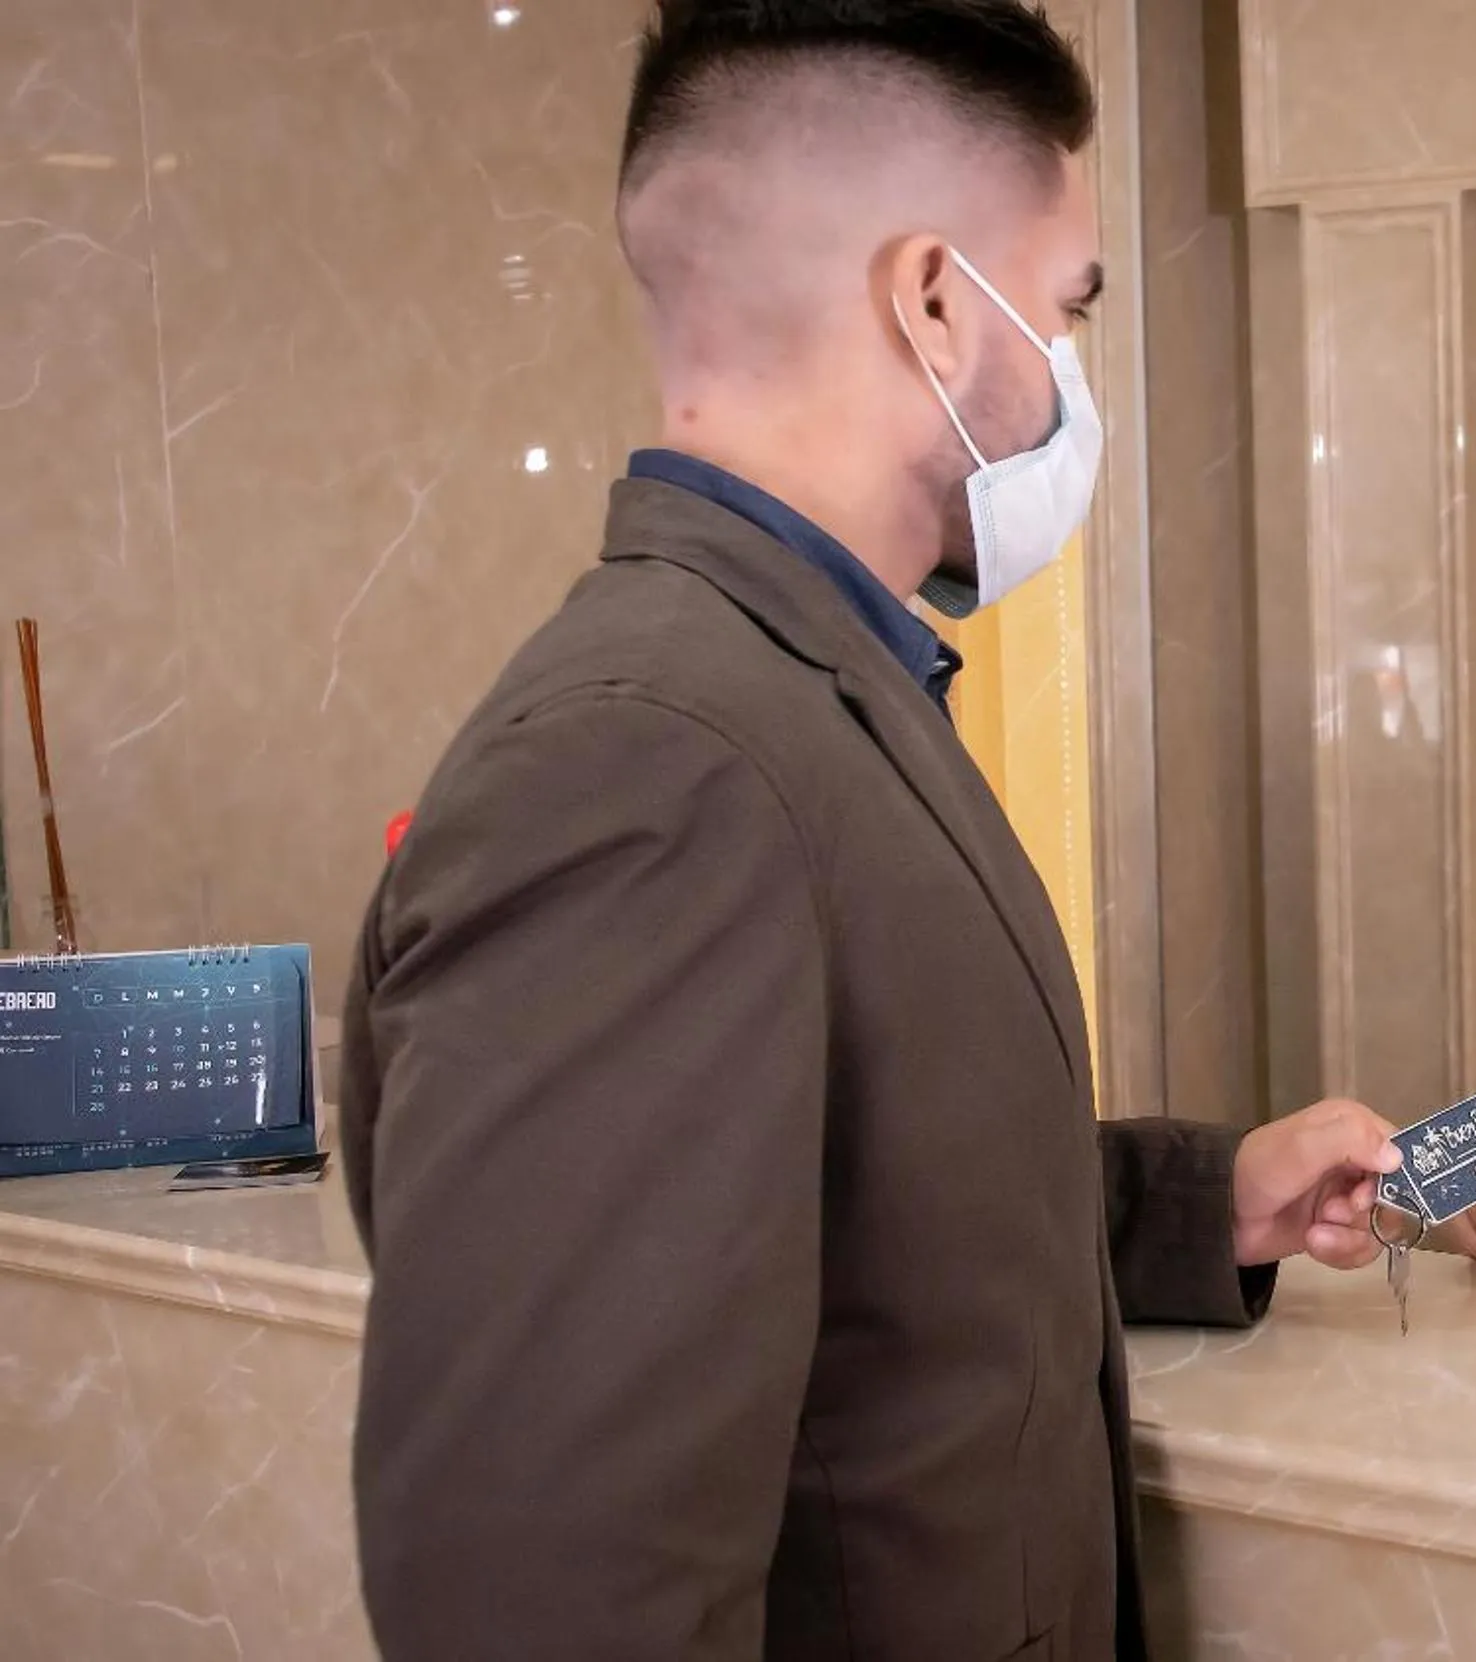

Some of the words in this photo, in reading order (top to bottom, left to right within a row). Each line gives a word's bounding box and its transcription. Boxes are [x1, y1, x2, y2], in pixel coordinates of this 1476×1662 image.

[121, 991, 131, 1001] L
[146, 989, 159, 1001] M
[173, 988, 185, 998] M
[226, 985, 236, 996] V
[118, 1082, 132, 1092] 22
